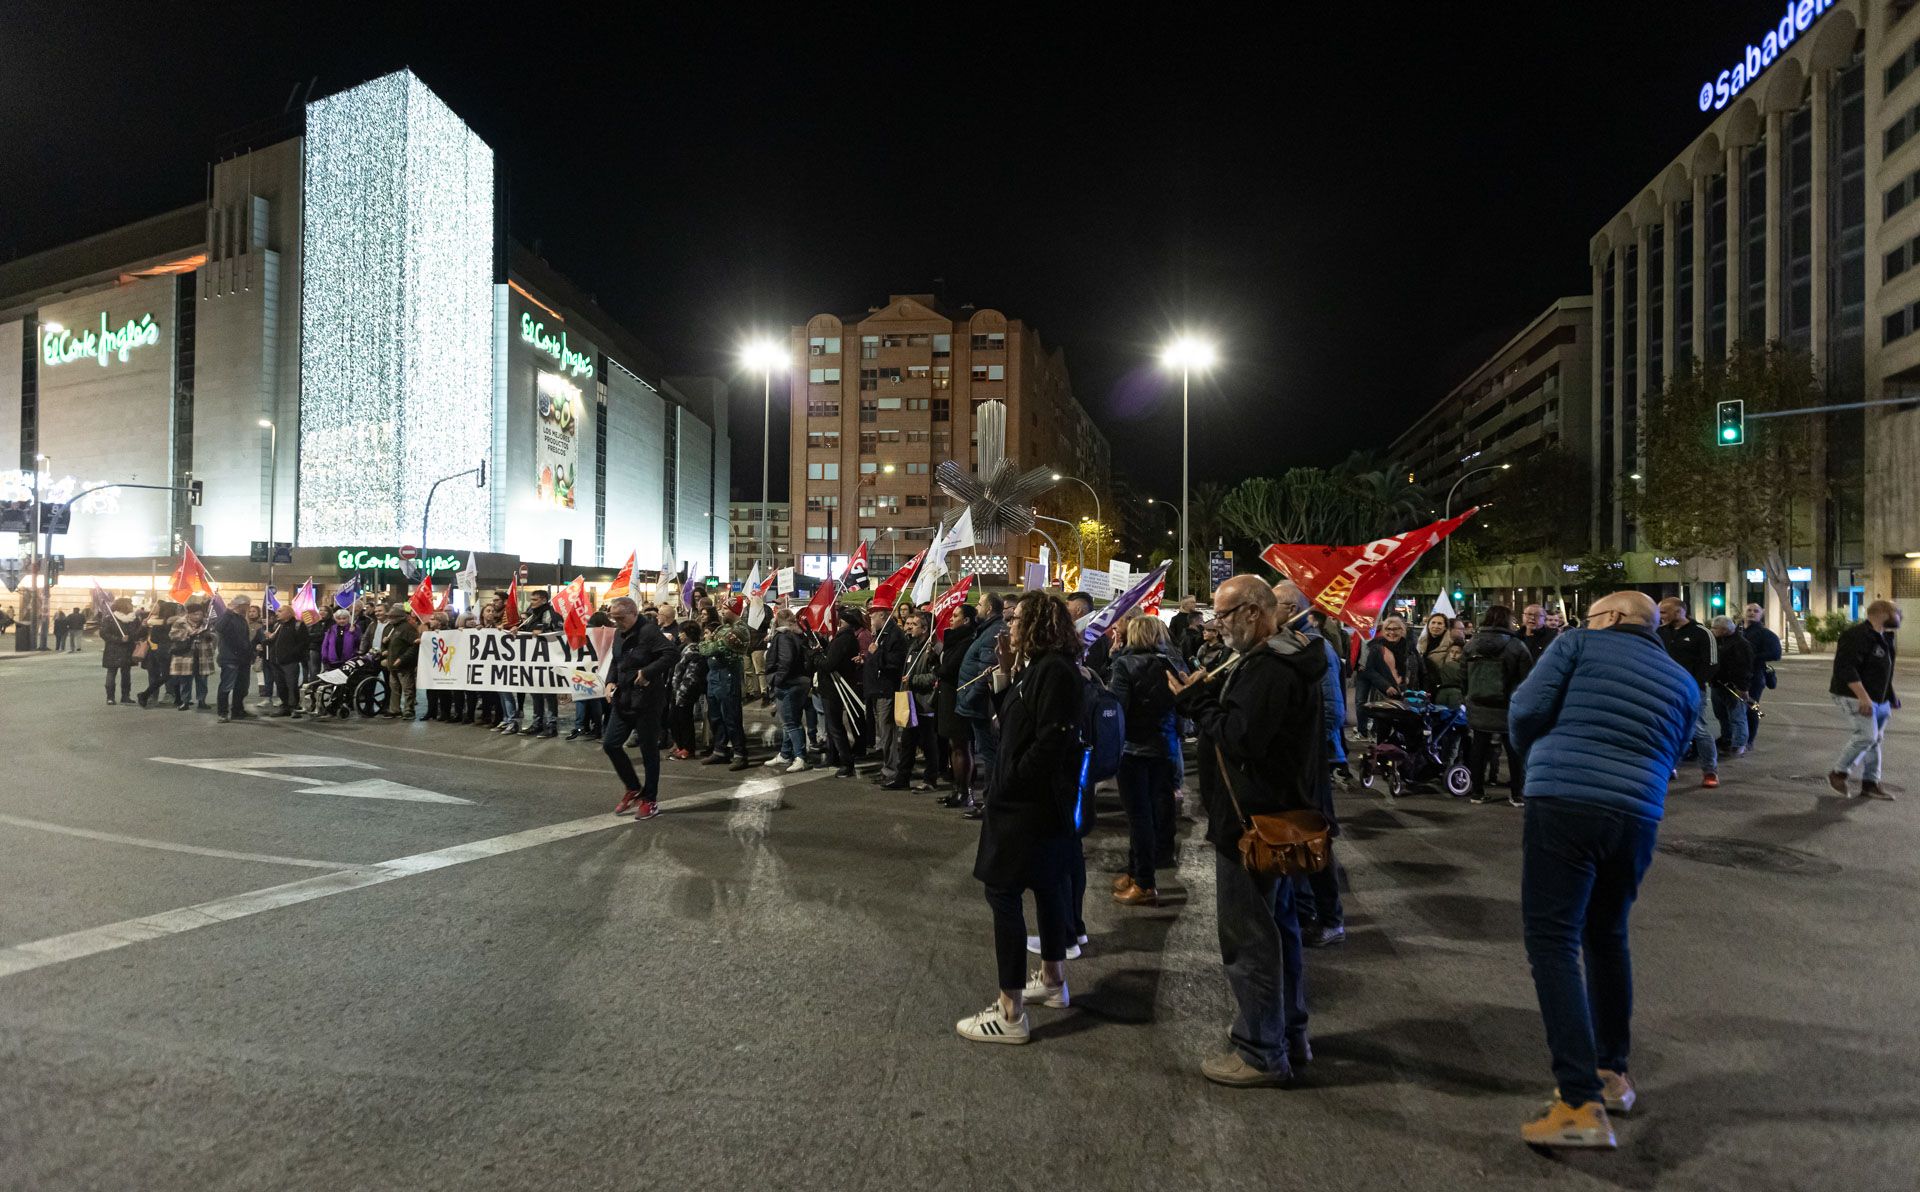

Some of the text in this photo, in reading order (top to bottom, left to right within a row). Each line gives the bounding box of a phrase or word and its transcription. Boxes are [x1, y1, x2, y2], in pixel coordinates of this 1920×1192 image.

[1714, 0, 1834, 110] Sabade
[43, 311, 159, 367] El Corte Inglés
[521, 312, 594, 378] El Corte Inglés
[543, 426, 570, 443] LOS MEJORES
[544, 435, 569, 450] PRODUCTOS
[547, 444, 566, 457] FRESCOS
[337, 550, 461, 577] El Corte nglés
[469, 634, 599, 662] BASTA YA
